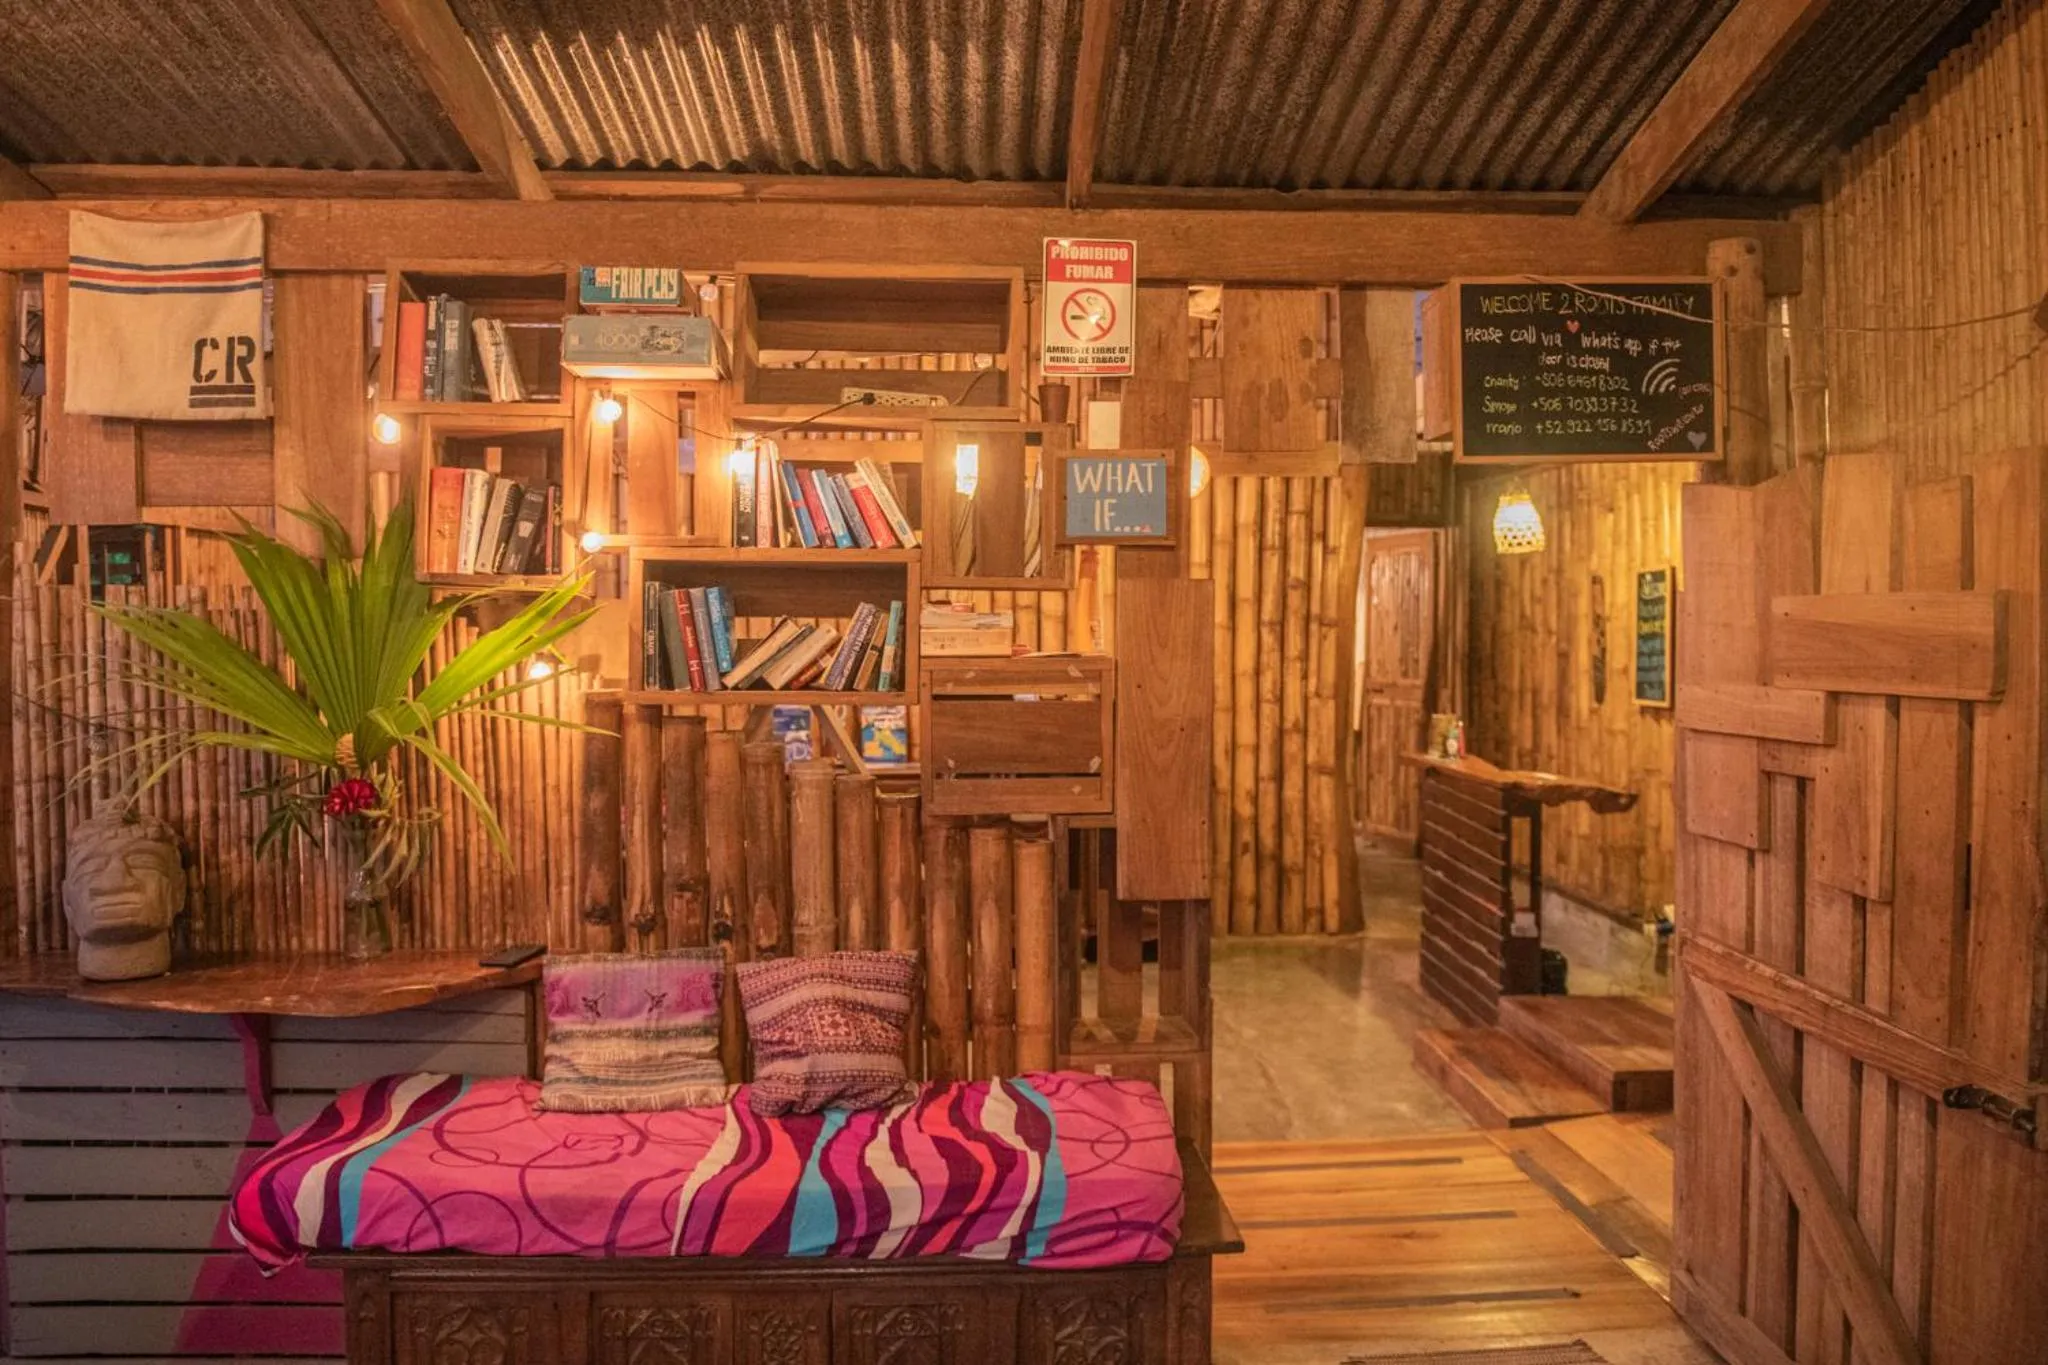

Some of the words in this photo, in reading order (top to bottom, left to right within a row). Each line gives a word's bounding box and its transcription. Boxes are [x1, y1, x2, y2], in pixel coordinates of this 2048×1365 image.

[1050, 245, 1129, 261] PROHIBIDO
[611, 266, 642, 299] FAIR
[644, 267, 678, 300] PLAY
[1065, 264, 1114, 280] FUMAR
[1479, 291, 1554, 315] WELCOME
[1558, 292, 1573, 315] 2
[1510, 324, 1537, 345] call
[1540, 331, 1563, 348] via
[192, 336, 256, 384] CR
[1073, 462, 1158, 494] WHAT
